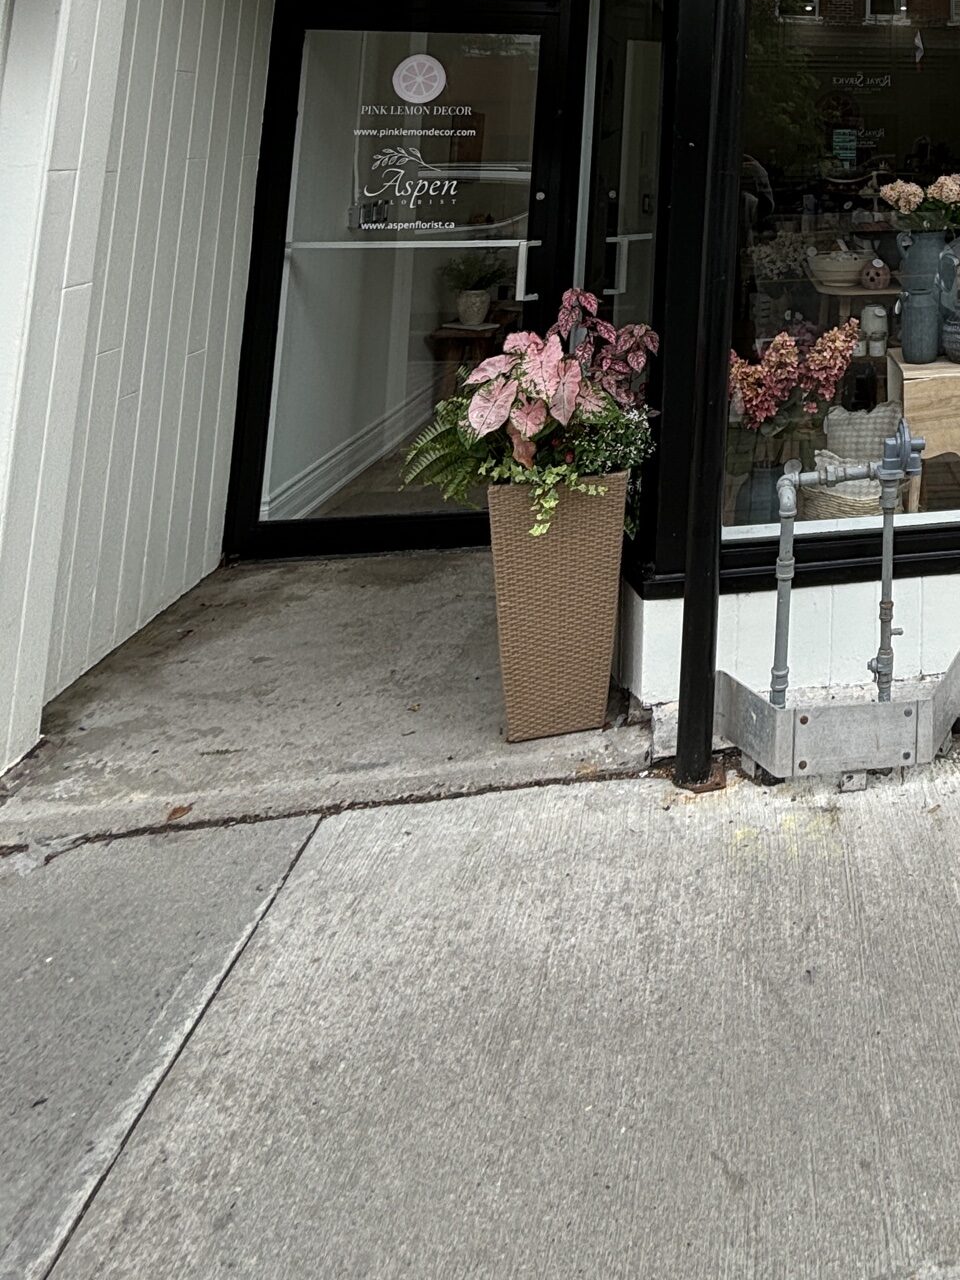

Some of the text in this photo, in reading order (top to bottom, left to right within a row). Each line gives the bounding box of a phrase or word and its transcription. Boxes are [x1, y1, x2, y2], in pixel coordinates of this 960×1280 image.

[360, 105, 473, 116] PINK LEMON DECOR
[353, 127, 477, 138] www.pinklemondecor.com
[363, 168, 458, 209] Aspen
[377, 198, 458, 206] FLORIST
[360, 220, 456, 231] www.aspenflorist.ca
